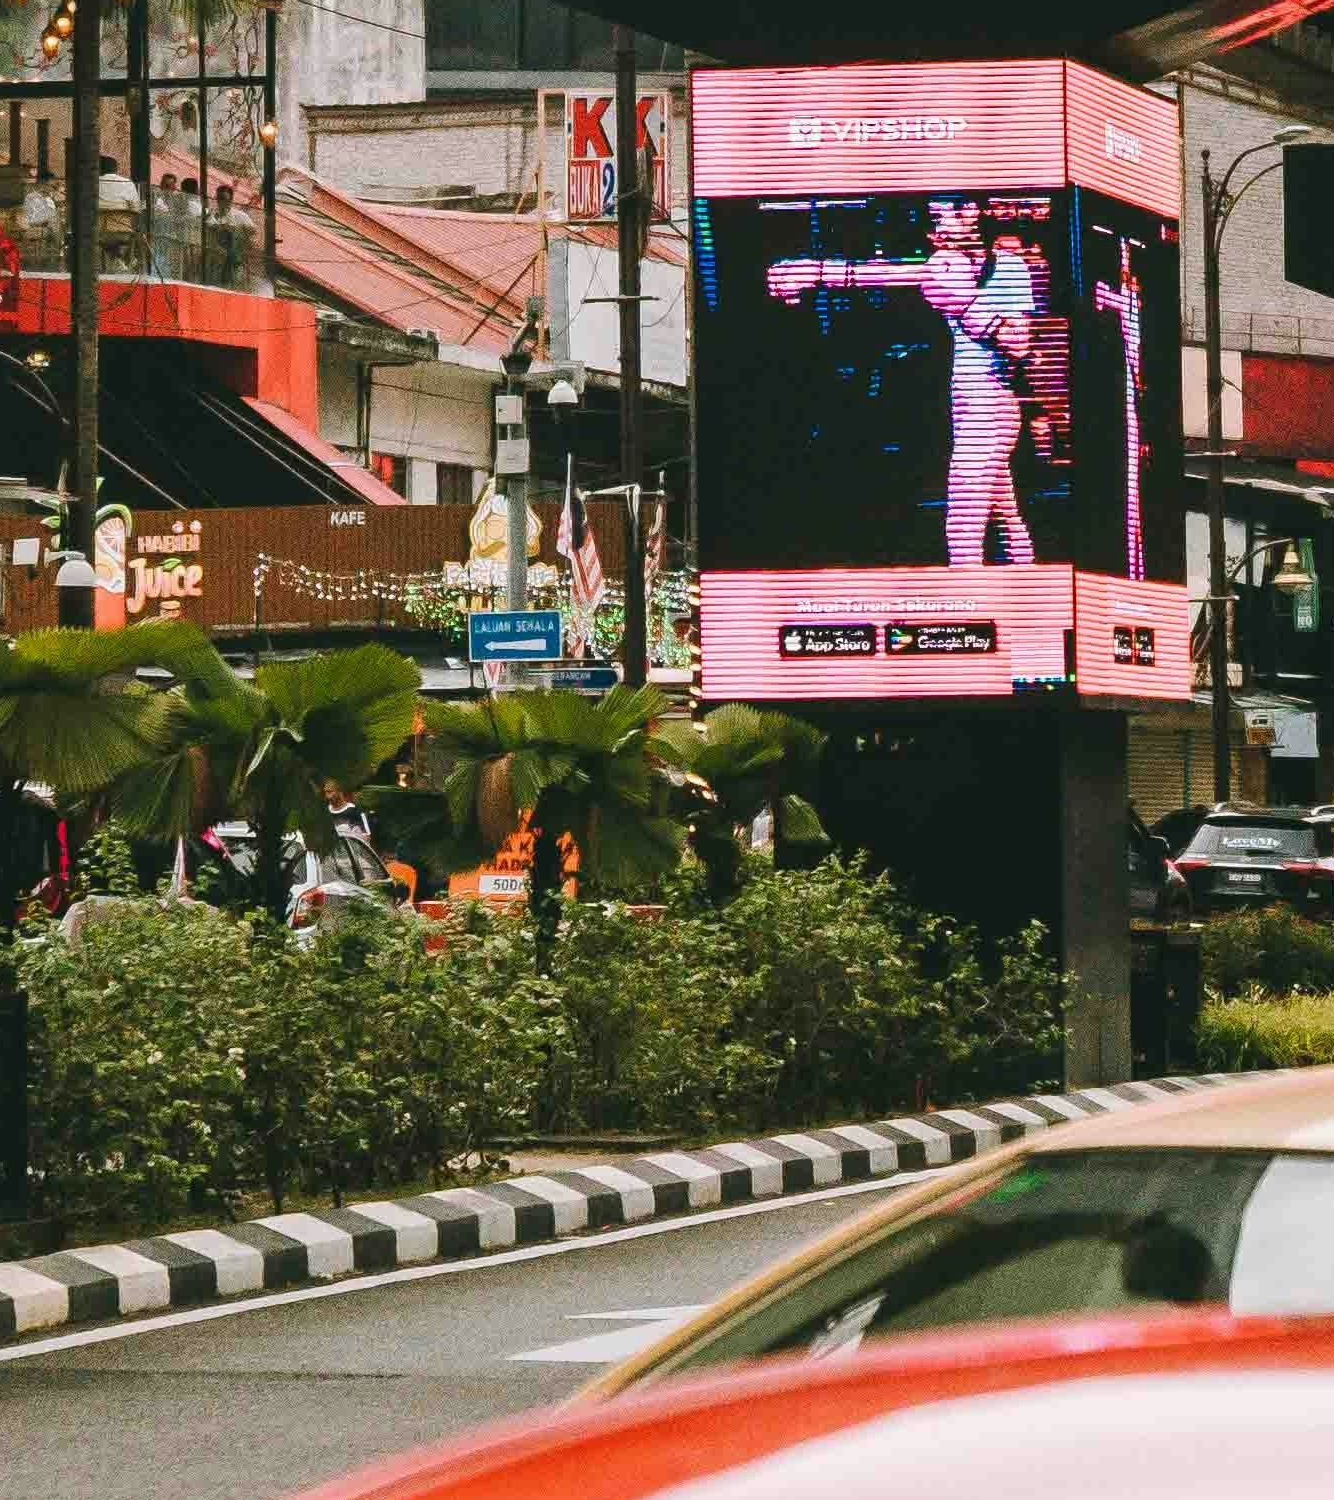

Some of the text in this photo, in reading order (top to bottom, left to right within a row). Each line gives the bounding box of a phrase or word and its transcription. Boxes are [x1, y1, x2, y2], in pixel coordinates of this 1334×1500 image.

[834, 118, 967, 144] VIPSHOP
[570, 164, 601, 214] BUKA
[330, 512, 366, 525] KAFE
[127, 558, 204, 614] Juice
[474, 619, 556, 633] LALUAN SEHALA
[806, 637, 871, 653] App Store
[917, 635, 990, 653] Google Play
